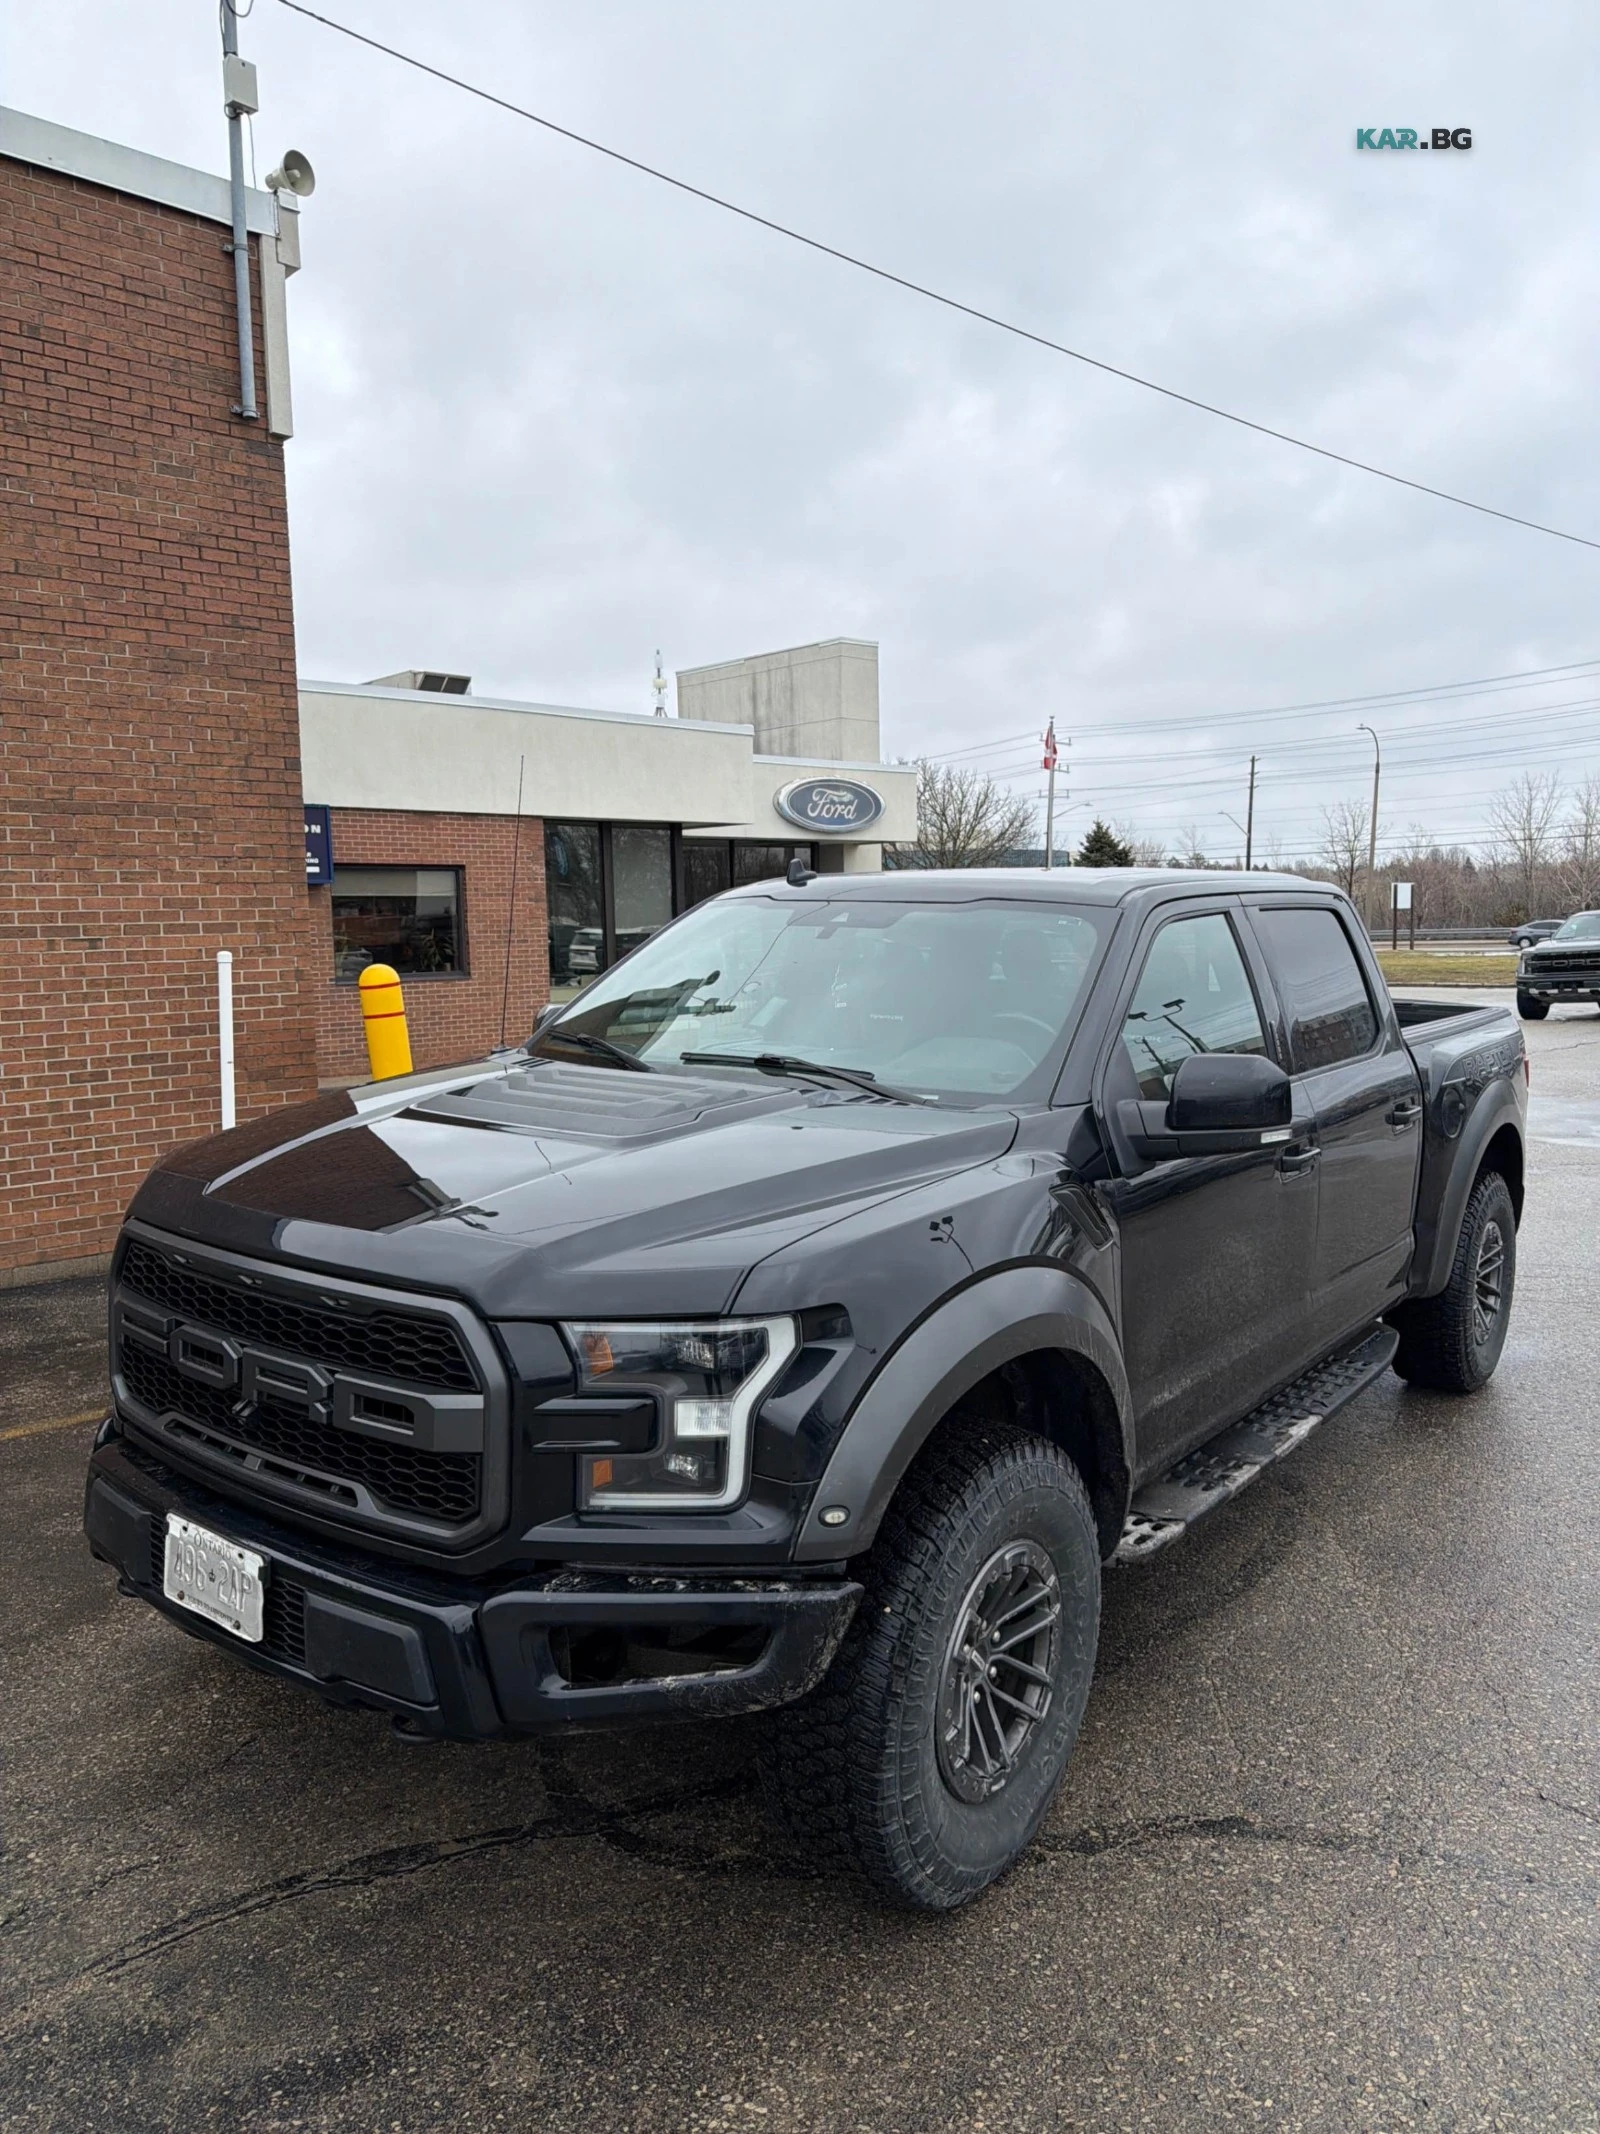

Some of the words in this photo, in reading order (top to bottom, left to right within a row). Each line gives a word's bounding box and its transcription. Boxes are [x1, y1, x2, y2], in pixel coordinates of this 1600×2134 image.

[807, 788, 859, 819] Ford
[1462, 1044, 1517, 1085] RAPTOR
[112, 1300, 442, 1453] FORD
[194, 1531, 233, 1561] ONTARIO
[218, 1560, 254, 1613] 2AP
